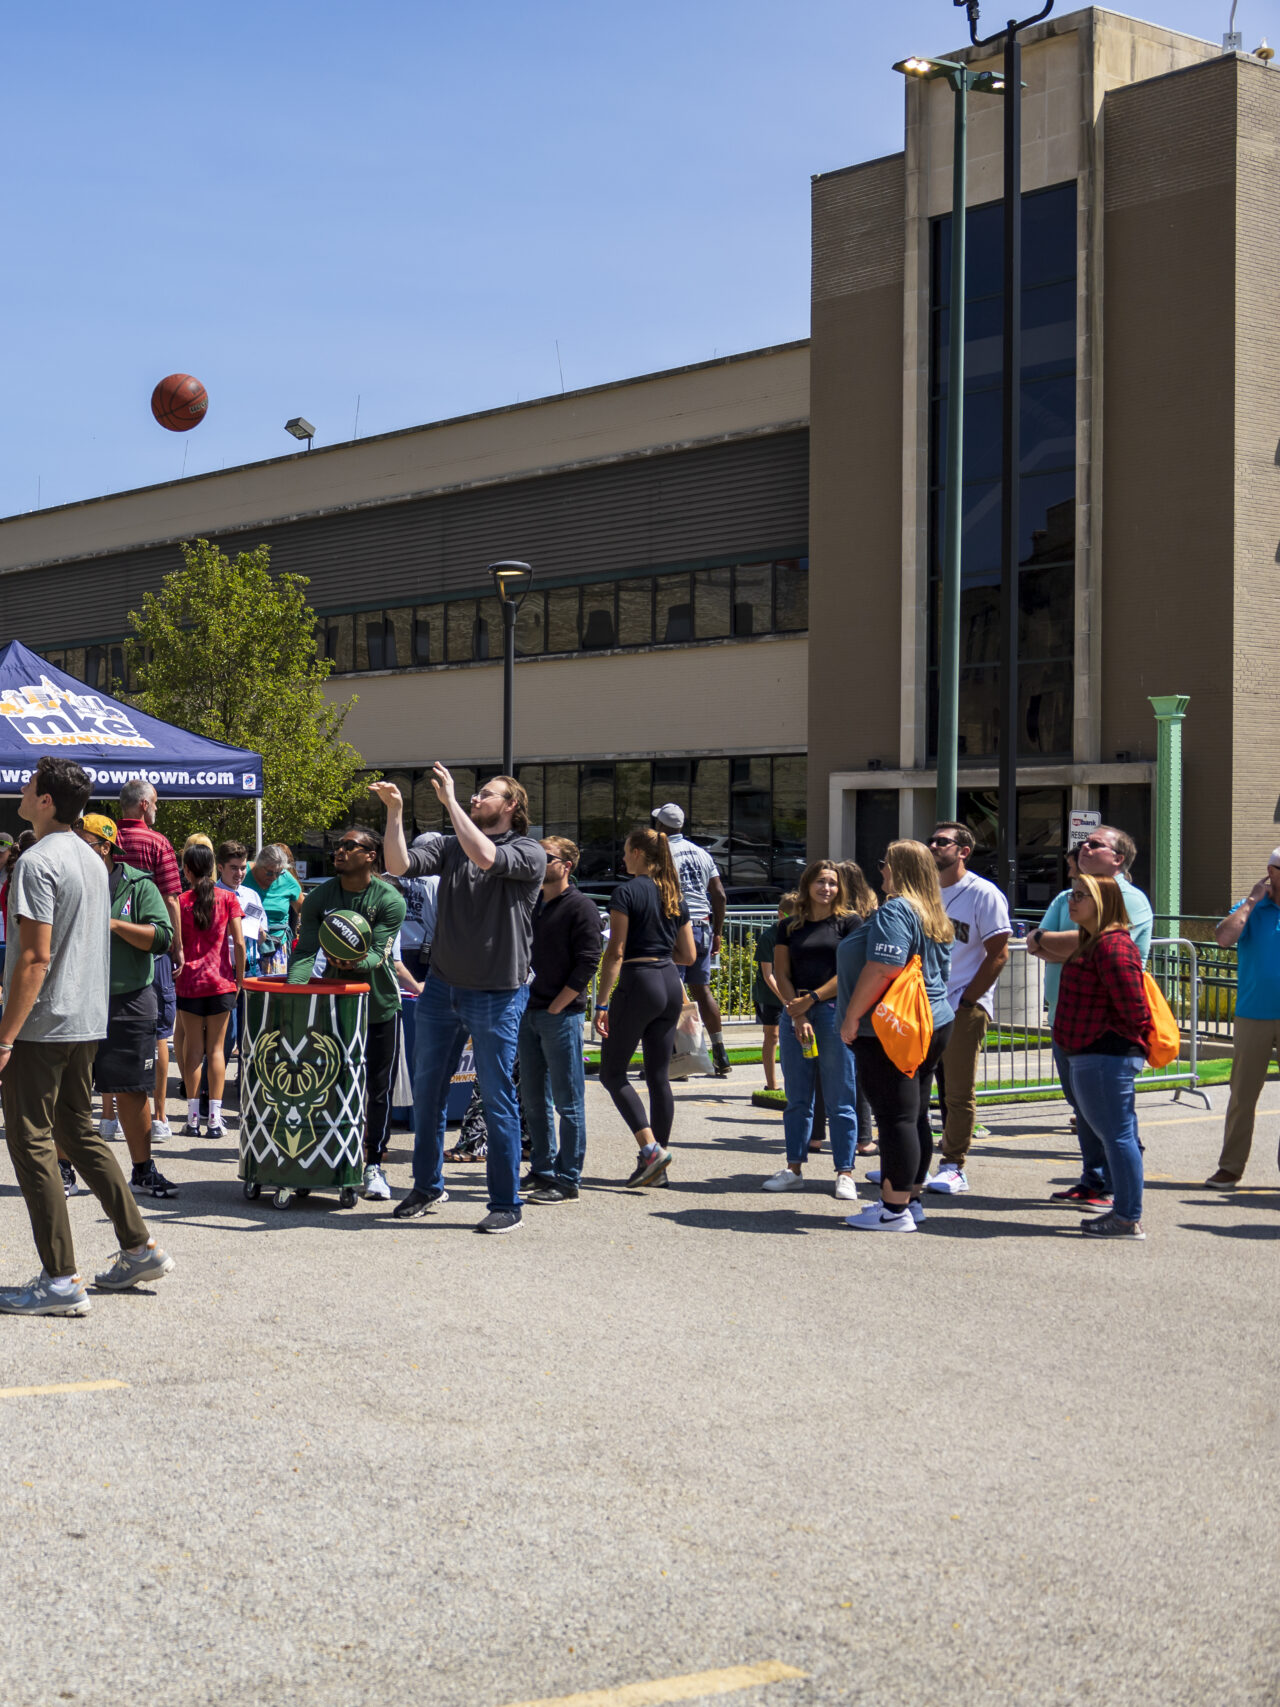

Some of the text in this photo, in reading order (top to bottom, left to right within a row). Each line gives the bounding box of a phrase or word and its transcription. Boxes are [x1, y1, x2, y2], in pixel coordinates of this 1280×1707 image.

[8, 701, 140, 738] mke
[26, 735, 152, 748] DOWNTOWN
[331, 917, 360, 948] Wilson
[885, 1014, 910, 1037] PNC
